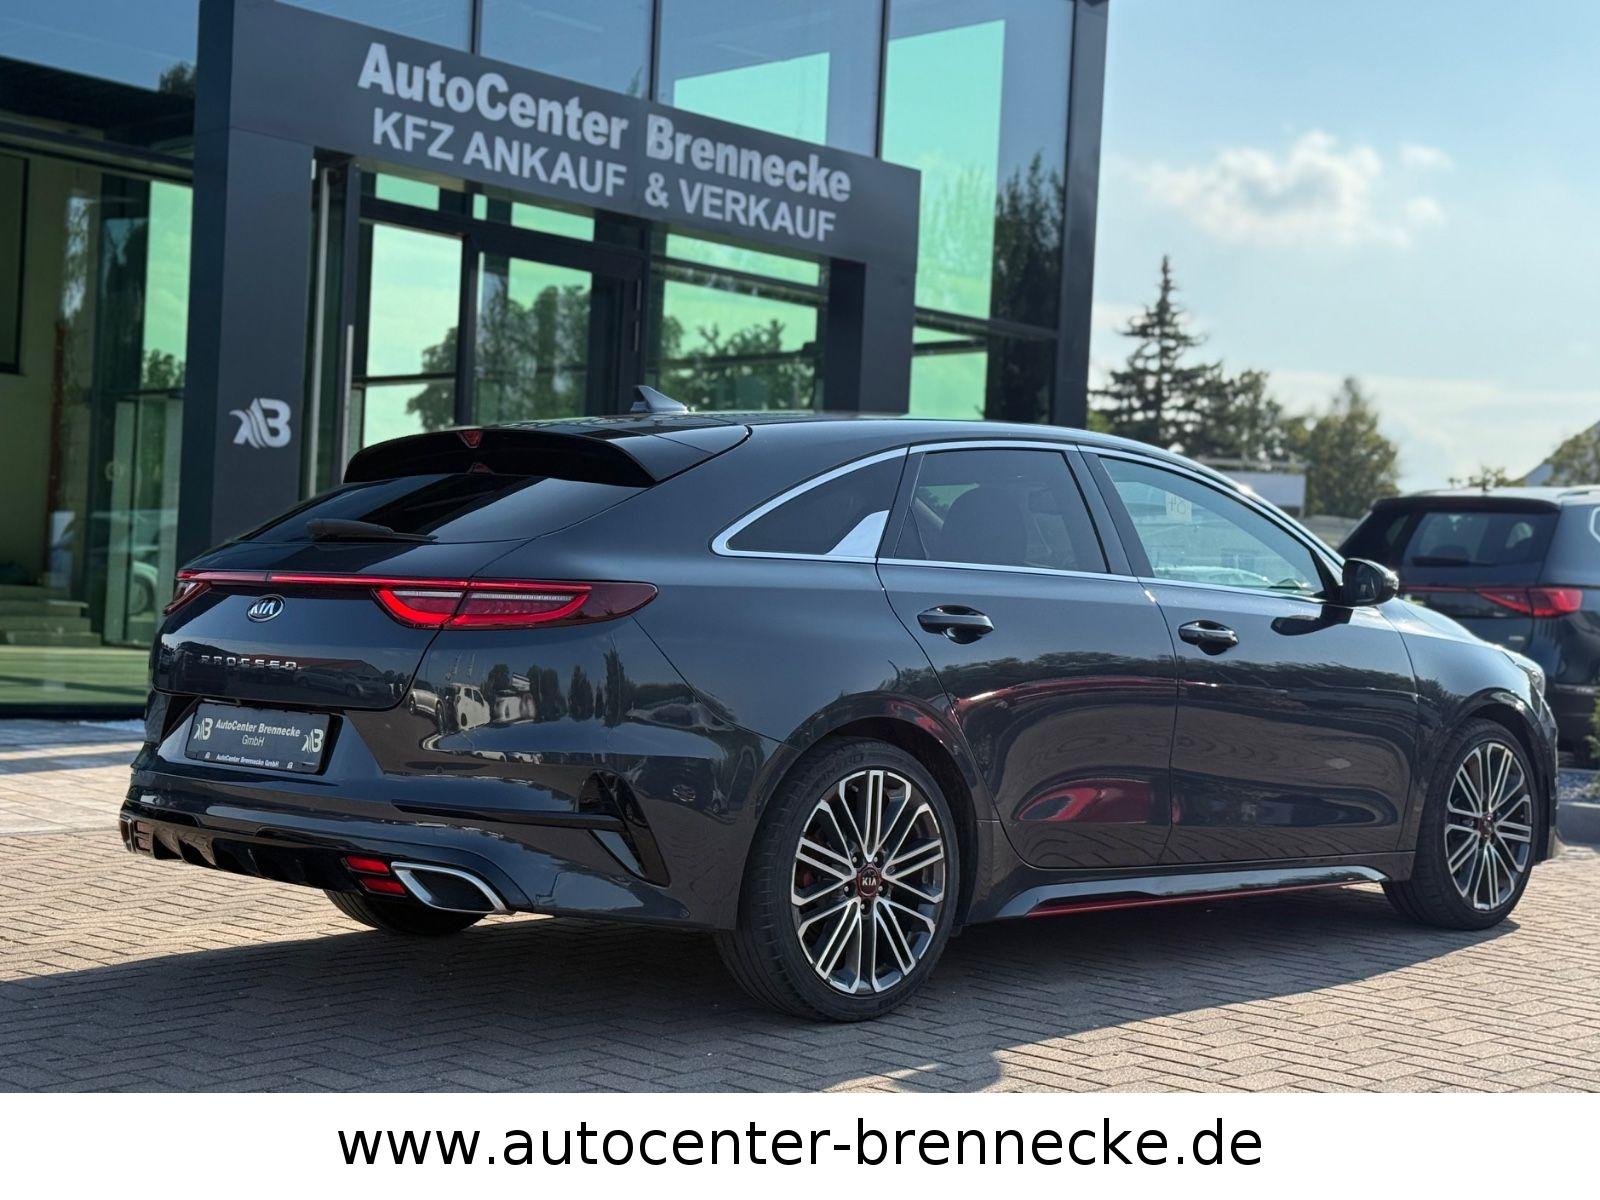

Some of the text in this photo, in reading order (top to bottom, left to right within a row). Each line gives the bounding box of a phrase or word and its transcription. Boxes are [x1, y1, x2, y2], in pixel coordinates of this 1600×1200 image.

[358, 42, 851, 201] AutoCenter Brennecke
[373, 107, 837, 242] KFZ ANKAUF & VERKAUF
[250, 600, 277, 615] KIA
[215, 719, 301, 738] AutoCenter Brennecke
[241, 734, 265, 747] GmbH
[862, 876, 877, 886] KIA
